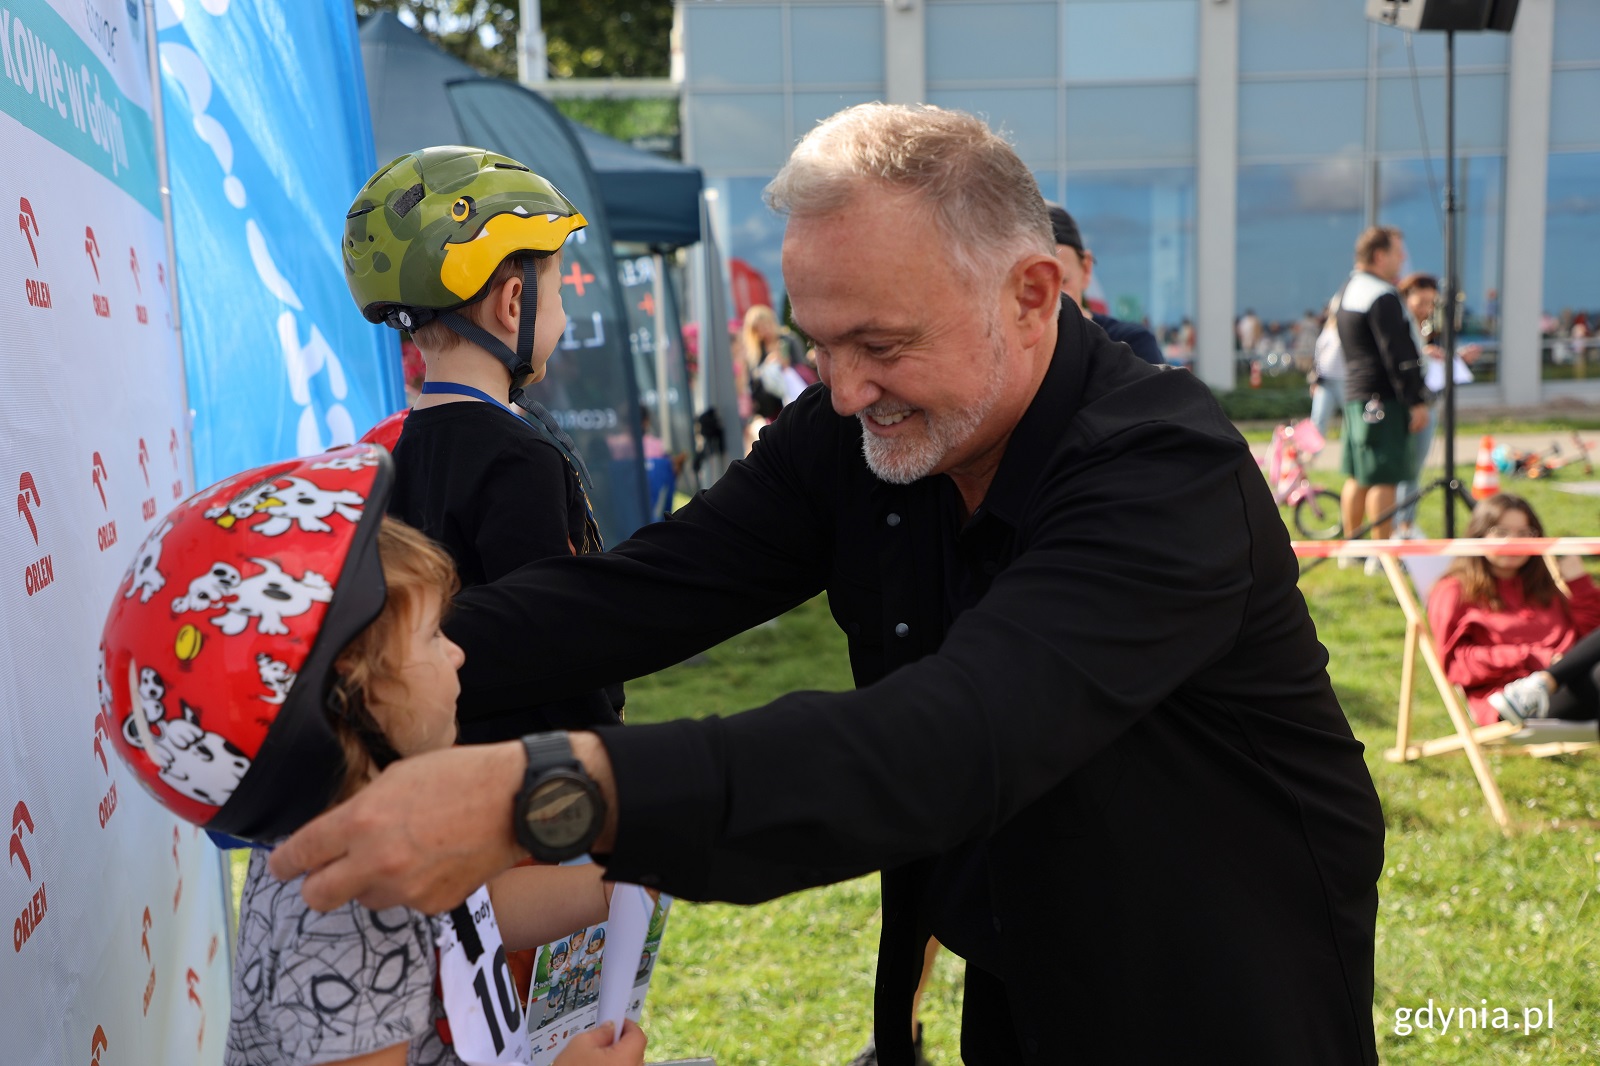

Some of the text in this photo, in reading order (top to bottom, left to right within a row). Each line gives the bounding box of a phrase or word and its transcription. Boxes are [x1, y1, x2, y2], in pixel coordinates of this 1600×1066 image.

[25, 278, 52, 309] ORLEN
[97, 519, 118, 552] ORLEN
[25, 555, 54, 597] ORLEN
[98, 780, 118, 830] ORLEN
[13, 881, 48, 953] ORLEN
